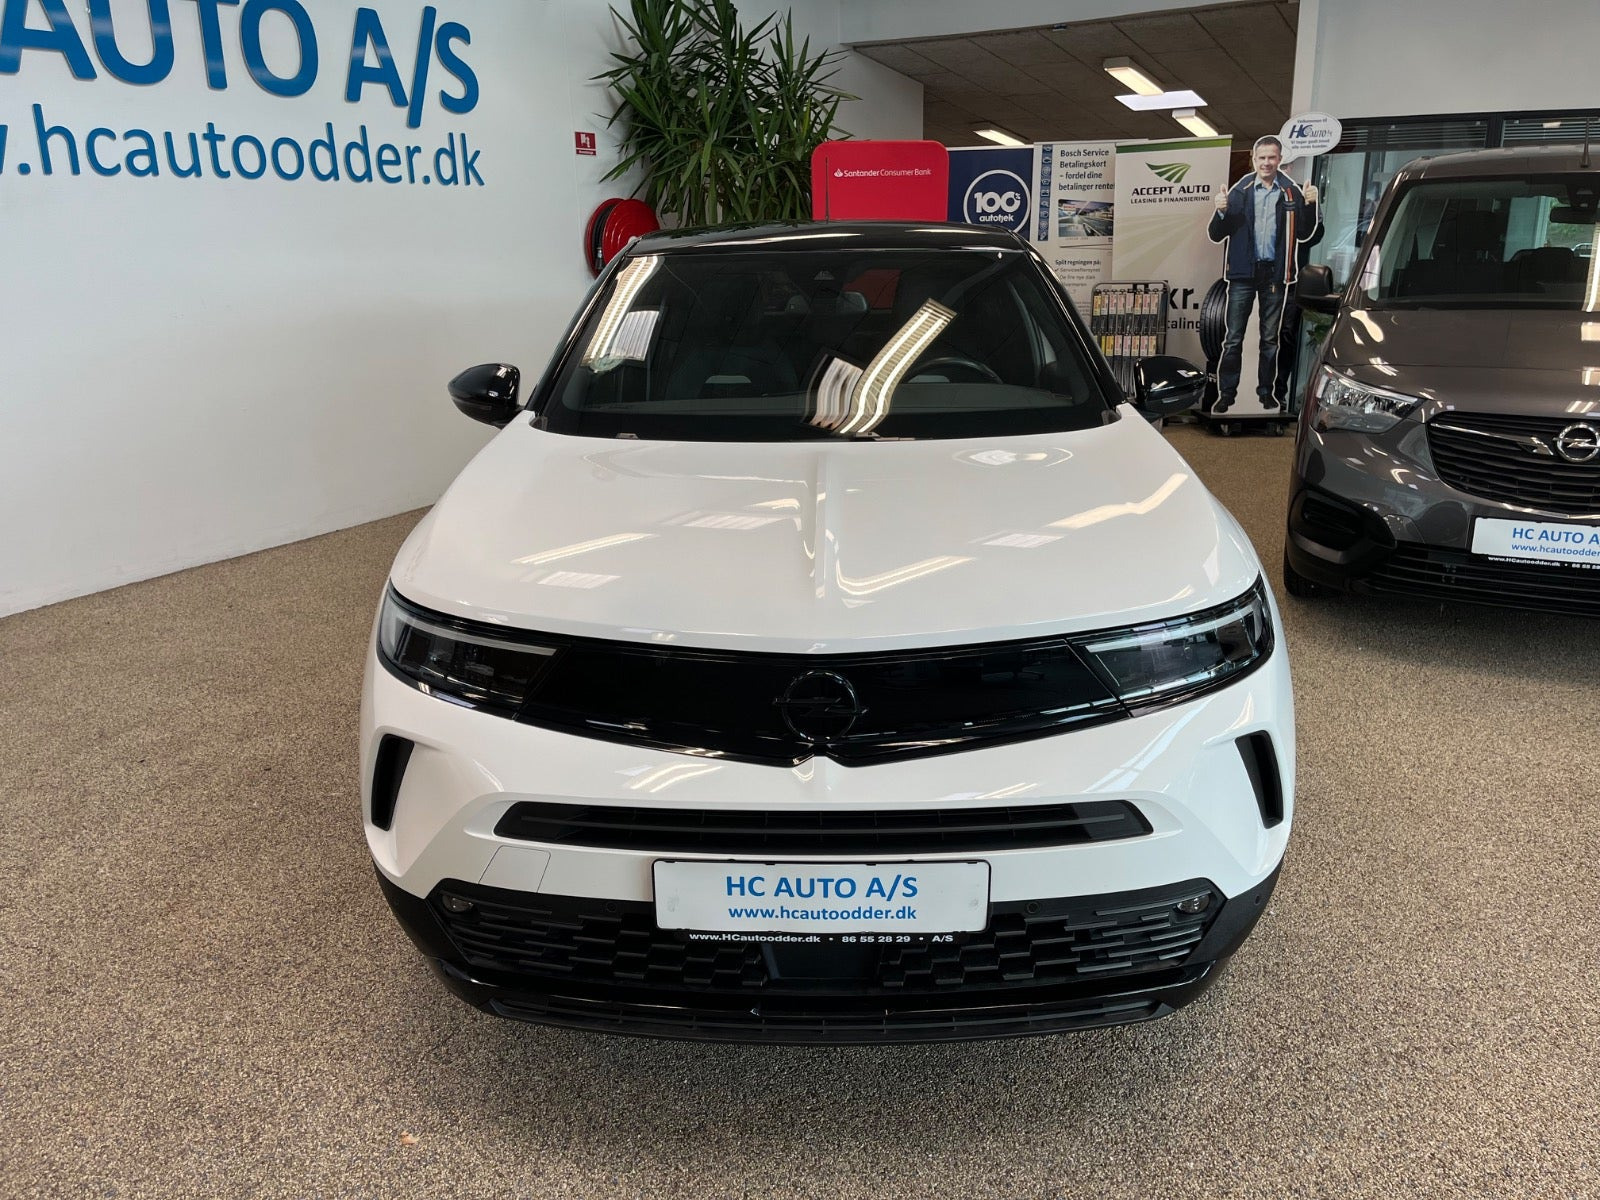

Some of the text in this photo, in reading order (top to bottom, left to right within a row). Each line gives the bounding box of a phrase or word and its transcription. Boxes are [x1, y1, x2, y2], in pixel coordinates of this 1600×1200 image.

[0, 0, 480, 128] AUTO A/S
[1060, 148, 1109, 157] Bosch Service
[1060, 160, 1106, 169] Betalingskort
[843, 168, 932, 177] Santander Consumer Bank
[1065, 171, 1085, 179] fordel
[1058, 182, 1094, 191] betalinger
[1131, 184, 1210, 196] ACCEPT AUTO
[1164, 195, 1210, 203] FINANSIERING
[1512, 527, 1600, 547] HC AUTO A
[726, 874, 918, 901] HC AUTO A/S
[728, 905, 917, 920] www.hcautoodder.dk
[689, 933, 821, 943] www.HCautoodder.dk
[932, 935, 954, 943] A/S
